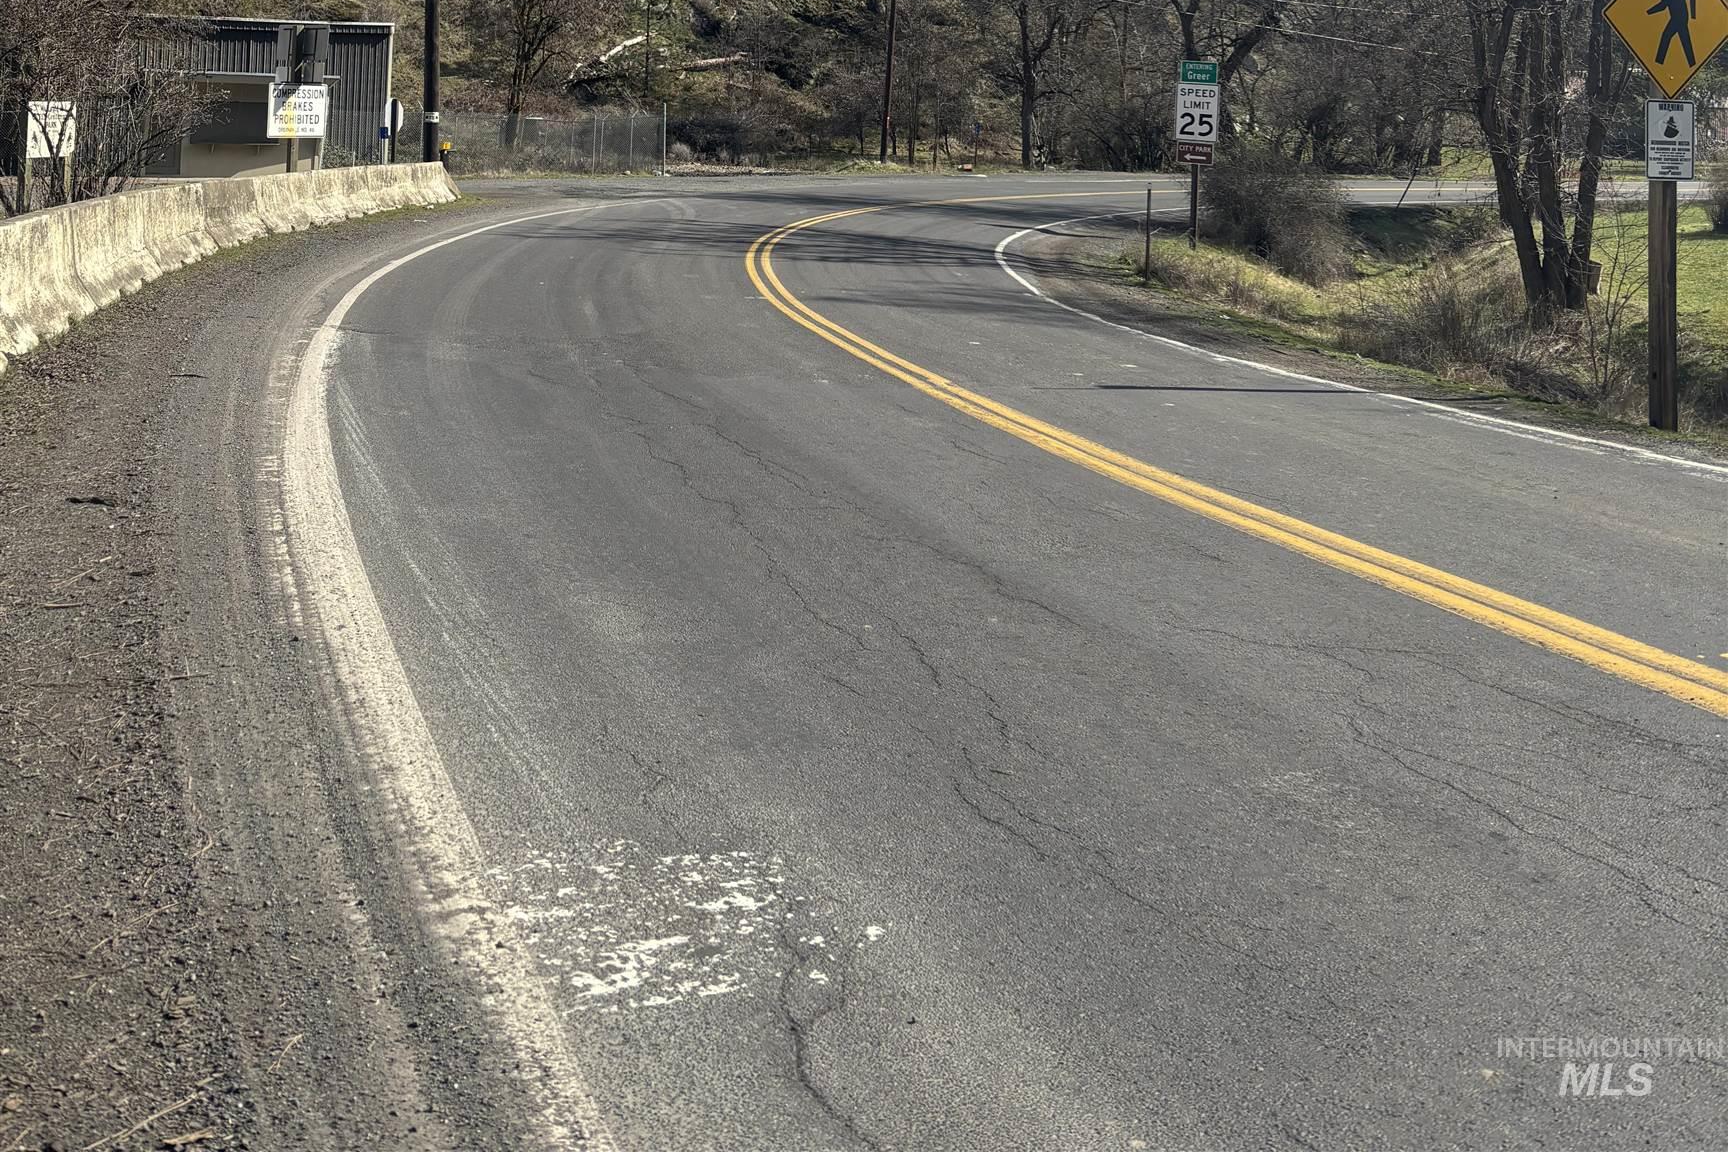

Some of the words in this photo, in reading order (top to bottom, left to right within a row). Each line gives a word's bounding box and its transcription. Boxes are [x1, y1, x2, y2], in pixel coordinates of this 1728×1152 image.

[1187, 70, 1210, 80] Greer
[272, 88, 324, 98] COMPRESSION
[1179, 87, 1215, 97] SPEED
[282, 101, 313, 111] BRAKES
[1183, 100, 1211, 109] LIMIT
[274, 114, 319, 124] PROHIBITED
[1179, 112, 1213, 136] 25
[1195, 145, 1211, 153] PARK
